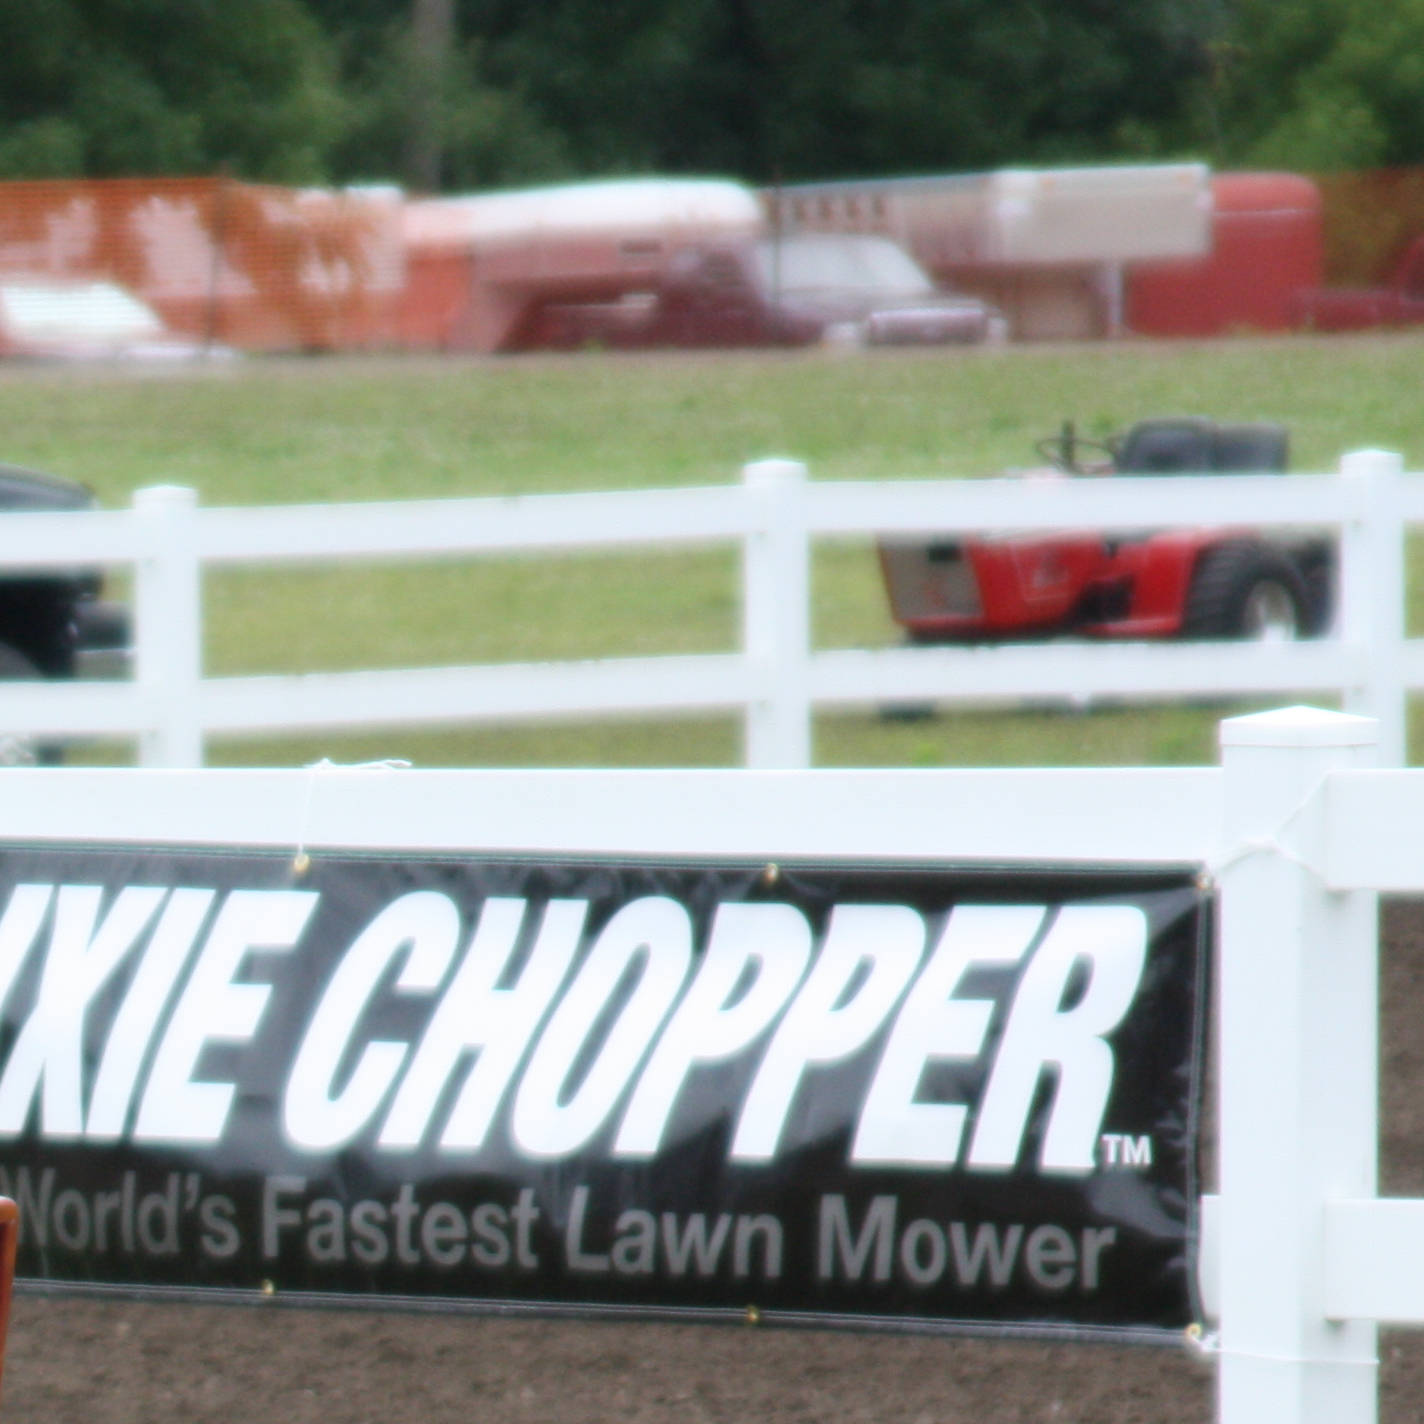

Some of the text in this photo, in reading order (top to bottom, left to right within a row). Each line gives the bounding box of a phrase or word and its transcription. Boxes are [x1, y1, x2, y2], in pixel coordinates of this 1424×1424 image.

[282, 891, 1149, 1176] CHOPPER
[262, 1176, 540, 1270] Fastest
[566, 1186, 784, 1279] Lawn
[817, 1193, 1117, 1290] Mower
